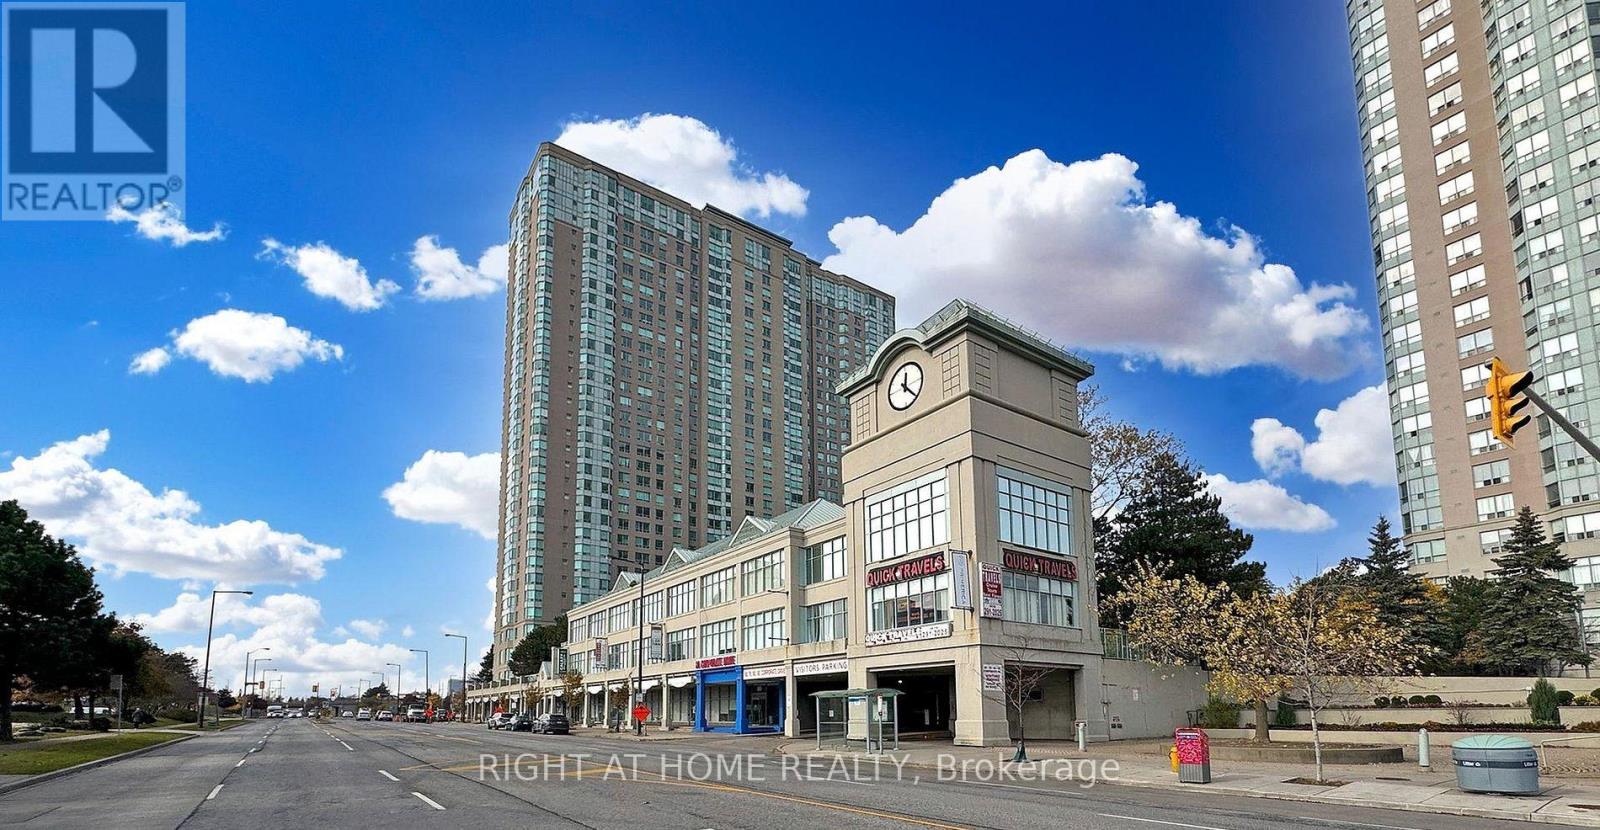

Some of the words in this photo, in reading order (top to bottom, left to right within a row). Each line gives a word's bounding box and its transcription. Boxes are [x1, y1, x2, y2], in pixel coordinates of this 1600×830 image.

[866, 567, 896, 587] QUICK
[897, 555, 944, 580] TRAVELS
[1005, 552, 1036, 571] QUICK
[1038, 559, 1078, 580] TRAVELS
[865, 631, 890, 644] QUICK
[795, 663, 820, 673] VISITORS
[822, 661, 848, 671] PARKING
